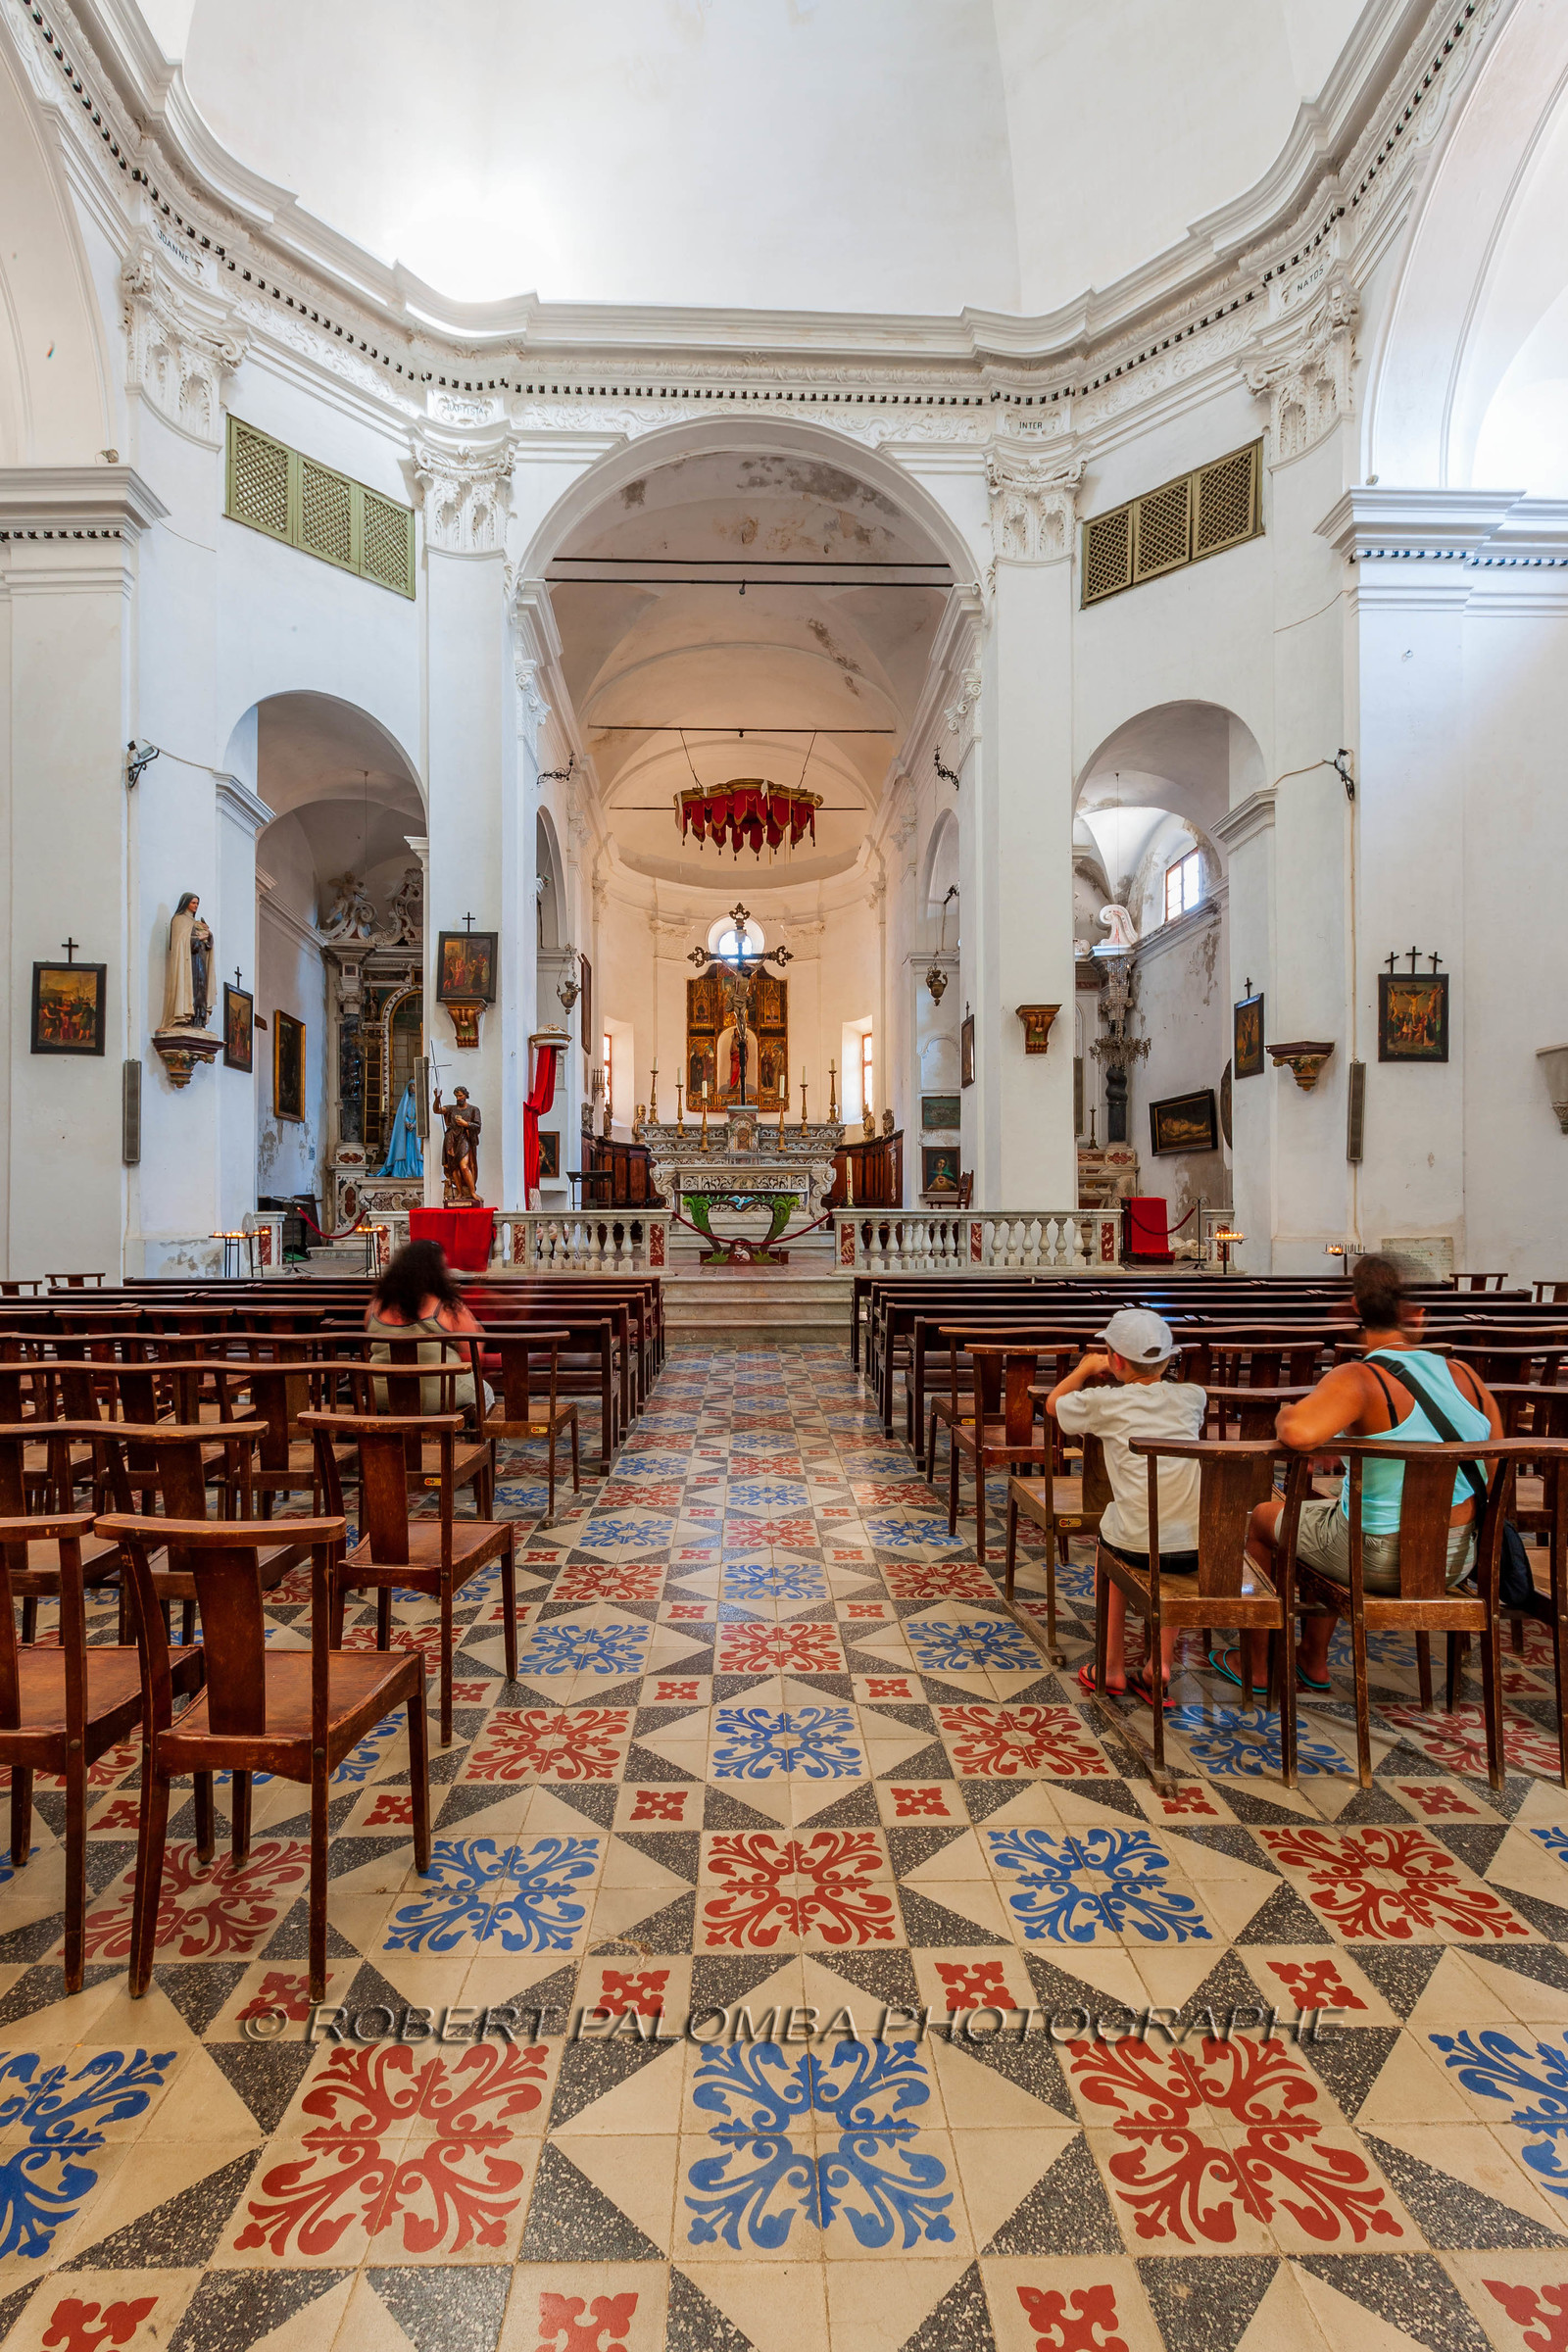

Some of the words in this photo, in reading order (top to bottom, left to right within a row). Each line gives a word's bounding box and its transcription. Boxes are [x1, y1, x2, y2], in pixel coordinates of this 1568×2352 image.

[158, 229, 190, 265] JOANNE
[1297, 264, 1324, 293] NATOS
[447, 403, 484, 416] BAPTISTA
